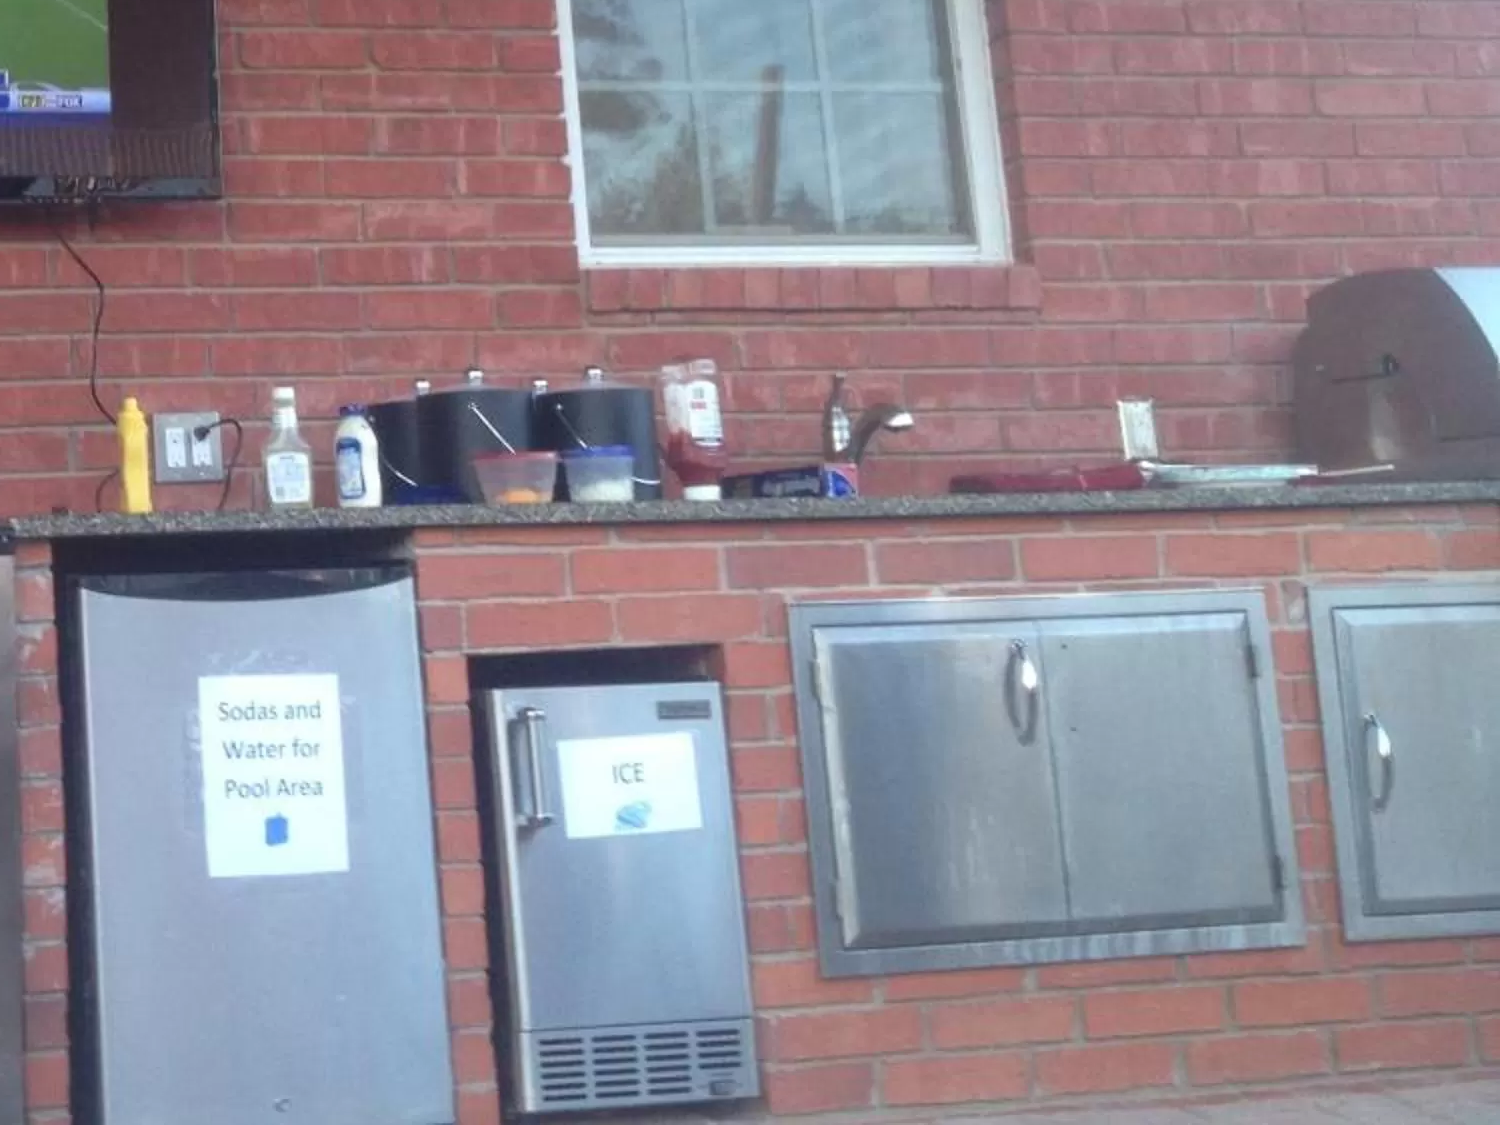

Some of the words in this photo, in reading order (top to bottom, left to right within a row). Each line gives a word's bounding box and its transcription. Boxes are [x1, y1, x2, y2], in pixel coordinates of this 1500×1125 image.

[217, 700, 278, 722] Sodas
[284, 700, 322, 720] and
[222, 740, 286, 759] Water
[292, 738, 320, 758] for
[612, 763, 646, 784] ICE
[224, 779, 270, 798] Pool
[276, 778, 324, 796] Area
